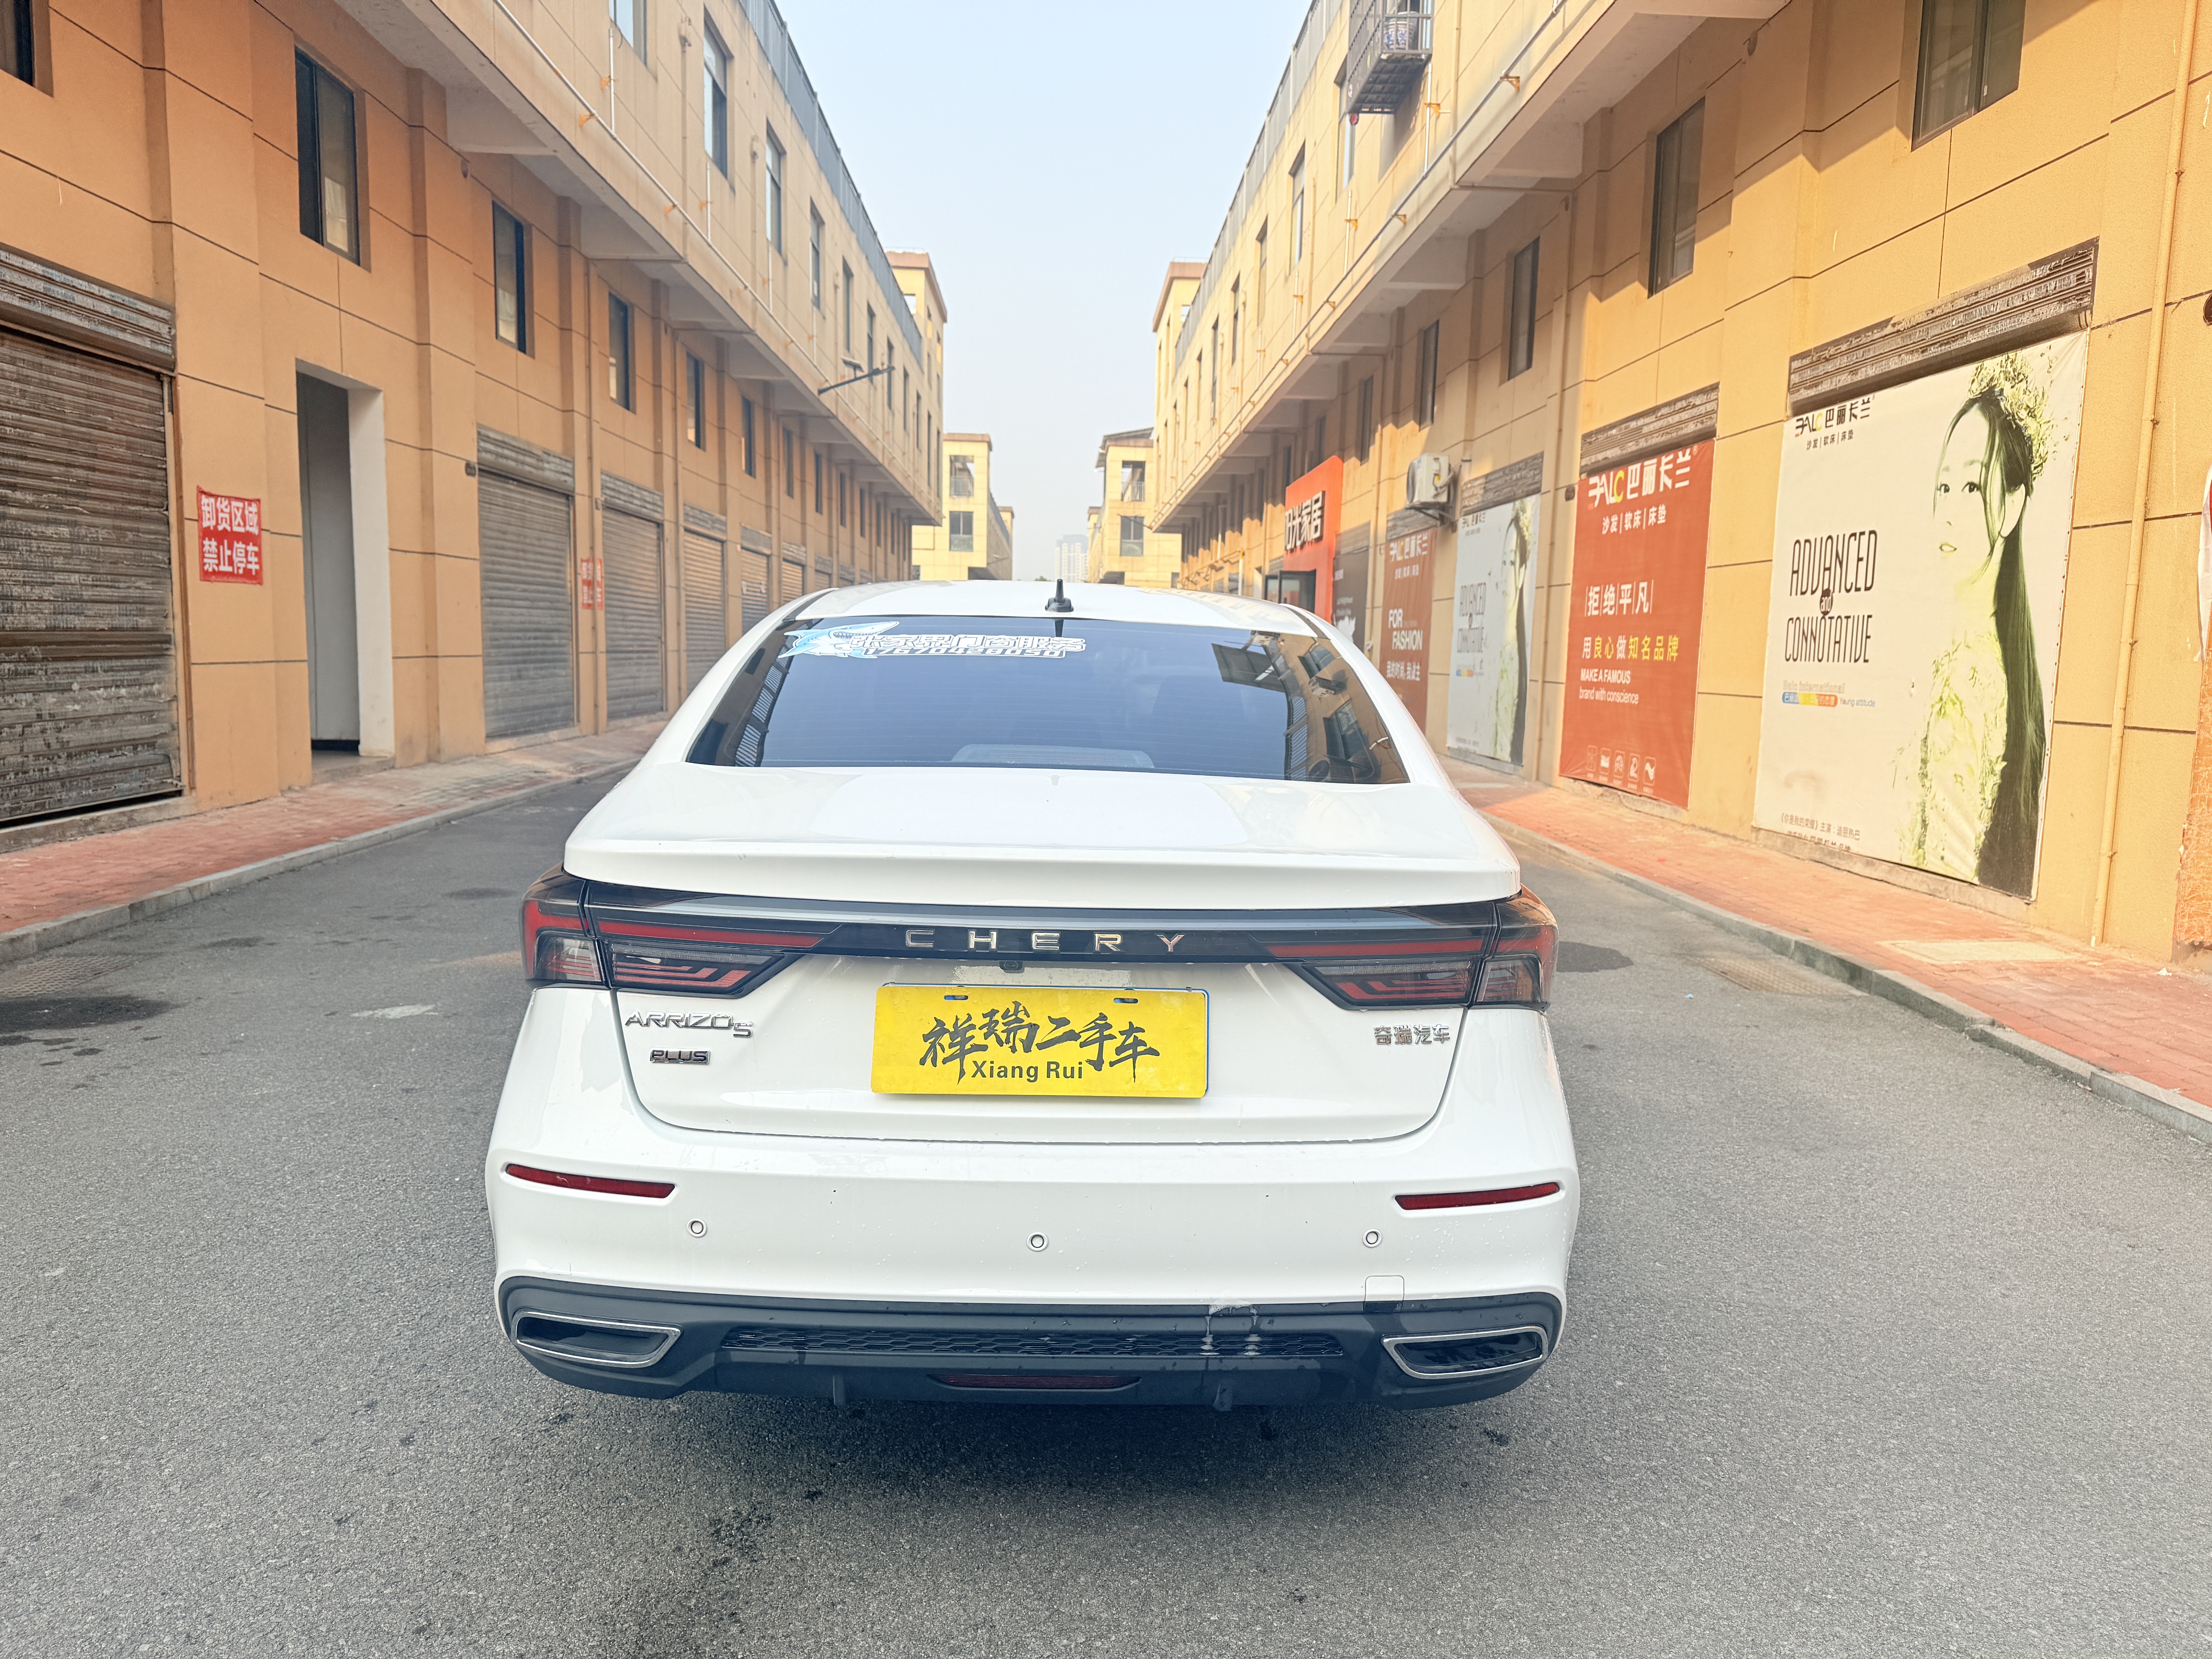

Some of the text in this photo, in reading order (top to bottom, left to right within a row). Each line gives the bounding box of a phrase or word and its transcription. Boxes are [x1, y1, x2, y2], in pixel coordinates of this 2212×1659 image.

[201, 494, 259, 535] 卸货区域
[203, 537, 260, 576] 禁止停车
[1790, 529, 1878, 596] ADVANCED
[1587, 582, 1649, 617] 拒绝平凡
[1388, 608, 1403, 629] FOR
[850, 634, 1085, 652] 张家界门窗服务
[1392, 629, 1423, 651] FASHION
[1582, 635, 1679, 662] 用良心做知名品牌
[1784, 614, 1873, 663] CONNOTATIVE
[866, 647, 1062, 657] 17670428050
[1580, 668, 1631, 684] MAKE A FAMOUS
[1579, 686, 1639, 704] brand with conscience
[905, 929, 1186, 952] CHERY
[919, 1000, 1160, 1085] 祥瑞二手车
[1374, 1024, 1450, 1045] 奇瑞汽车
[651, 1049, 708, 1063] PLUS
[971, 1060, 1083, 1083] Xiang Rui
